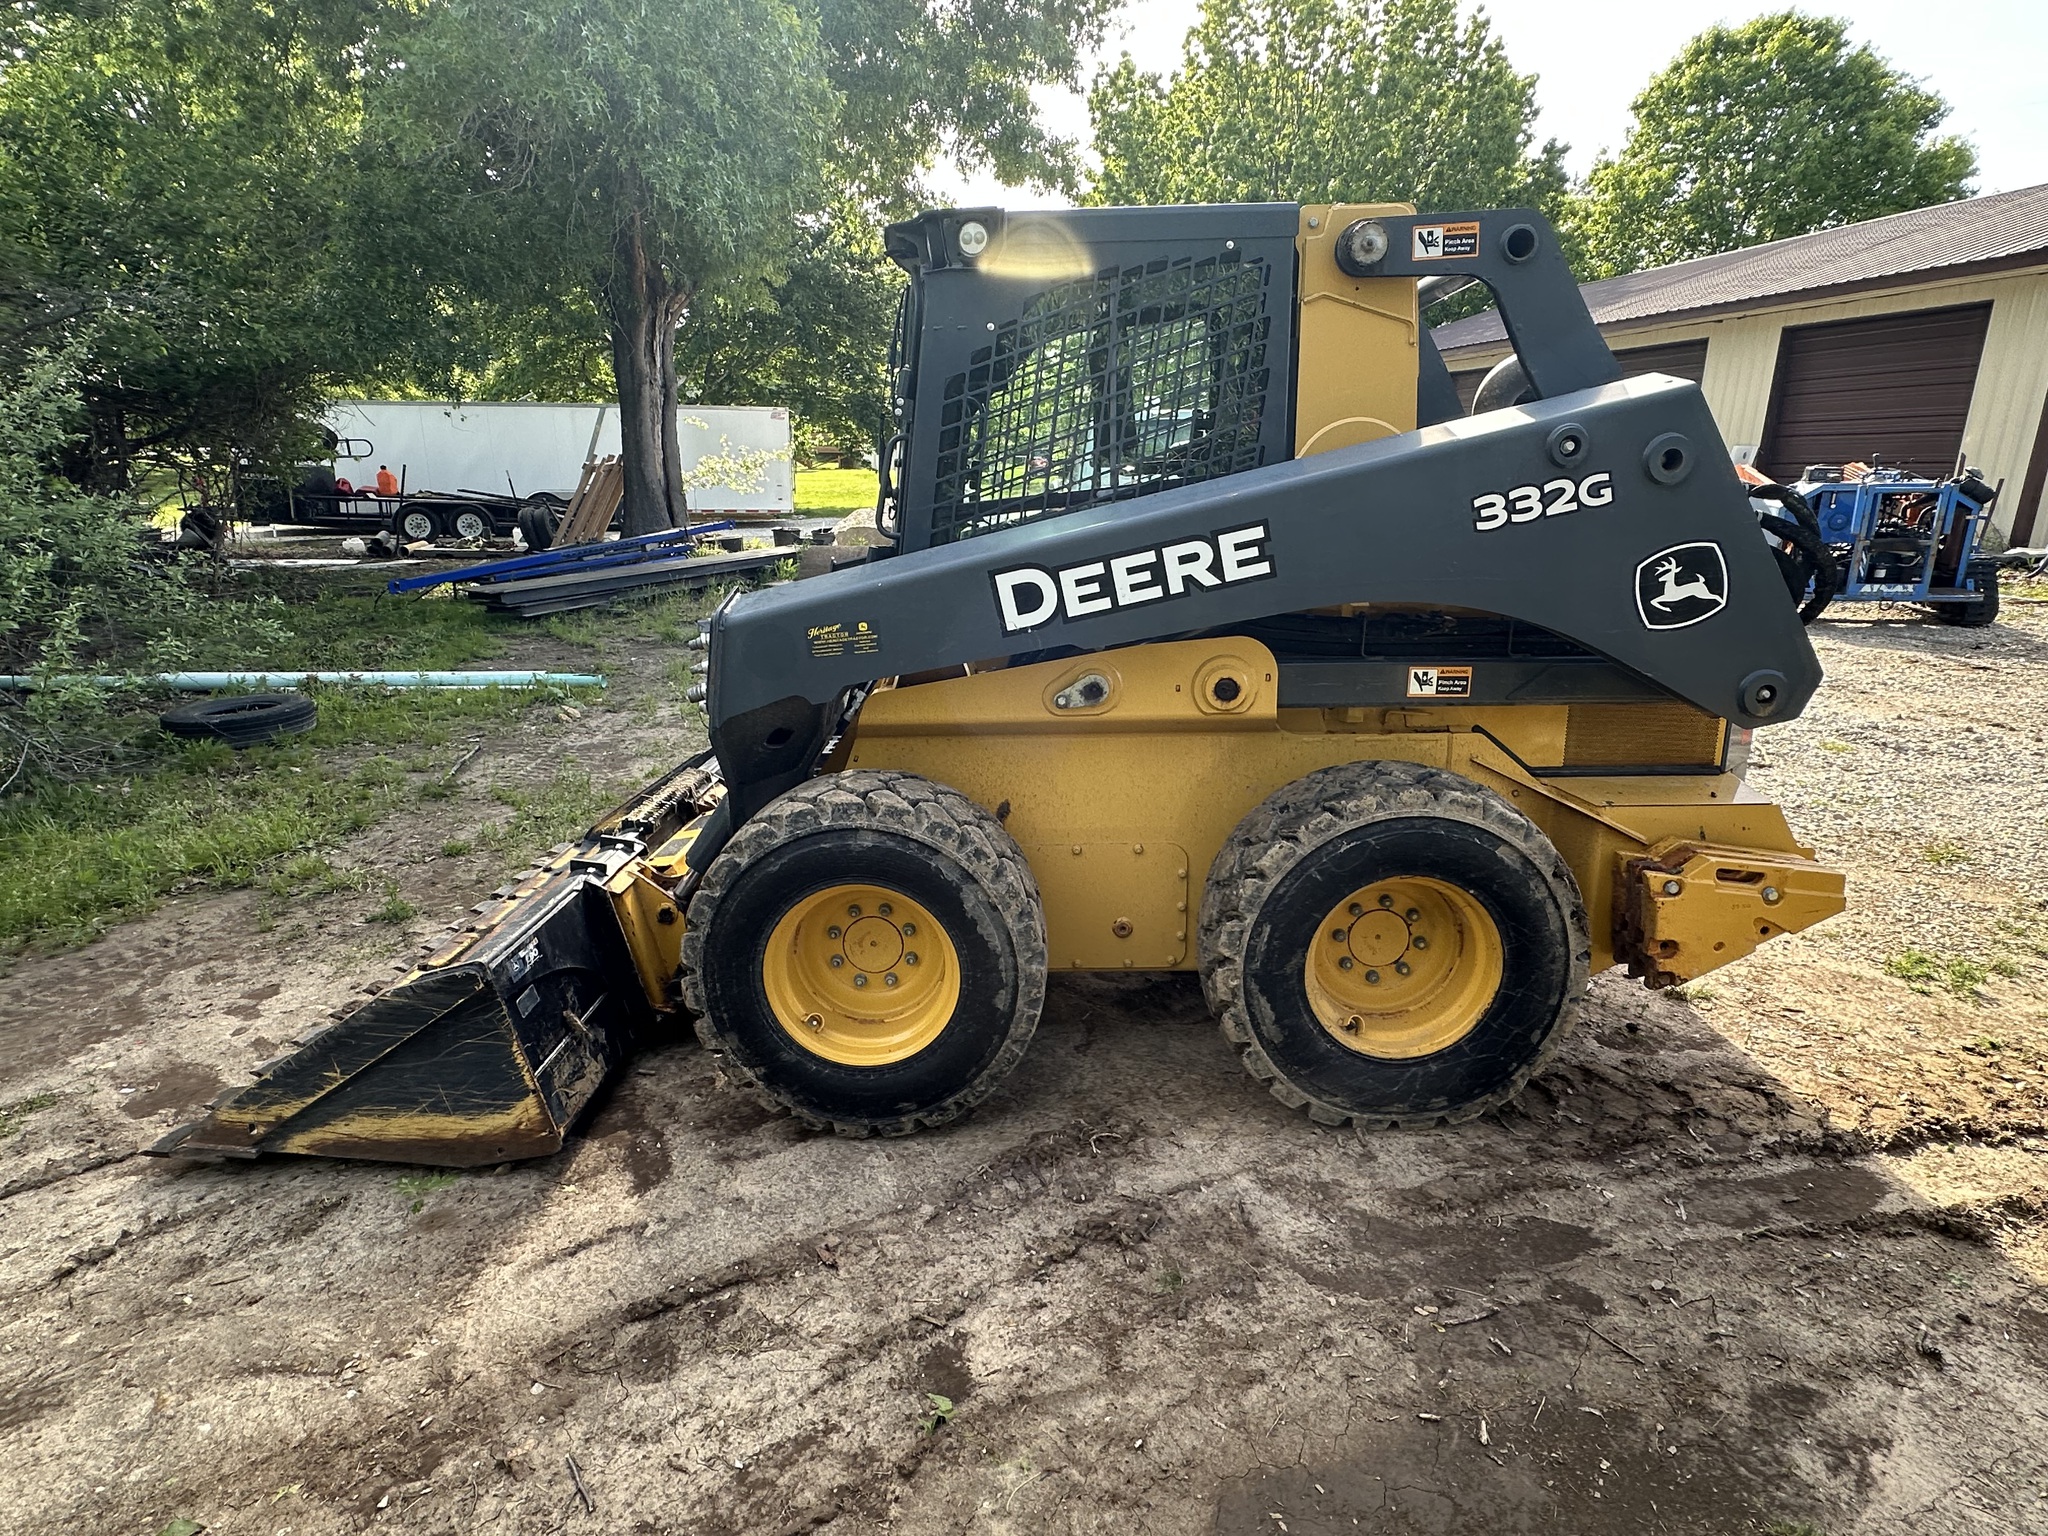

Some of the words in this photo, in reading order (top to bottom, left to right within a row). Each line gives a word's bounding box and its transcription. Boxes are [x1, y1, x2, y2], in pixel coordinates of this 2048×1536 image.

[1473, 472, 1613, 531] 332G
[994, 525, 1272, 632] DEERE
[807, 623, 841, 639] Heritage
[820, 631, 849, 640] TRACTOR
